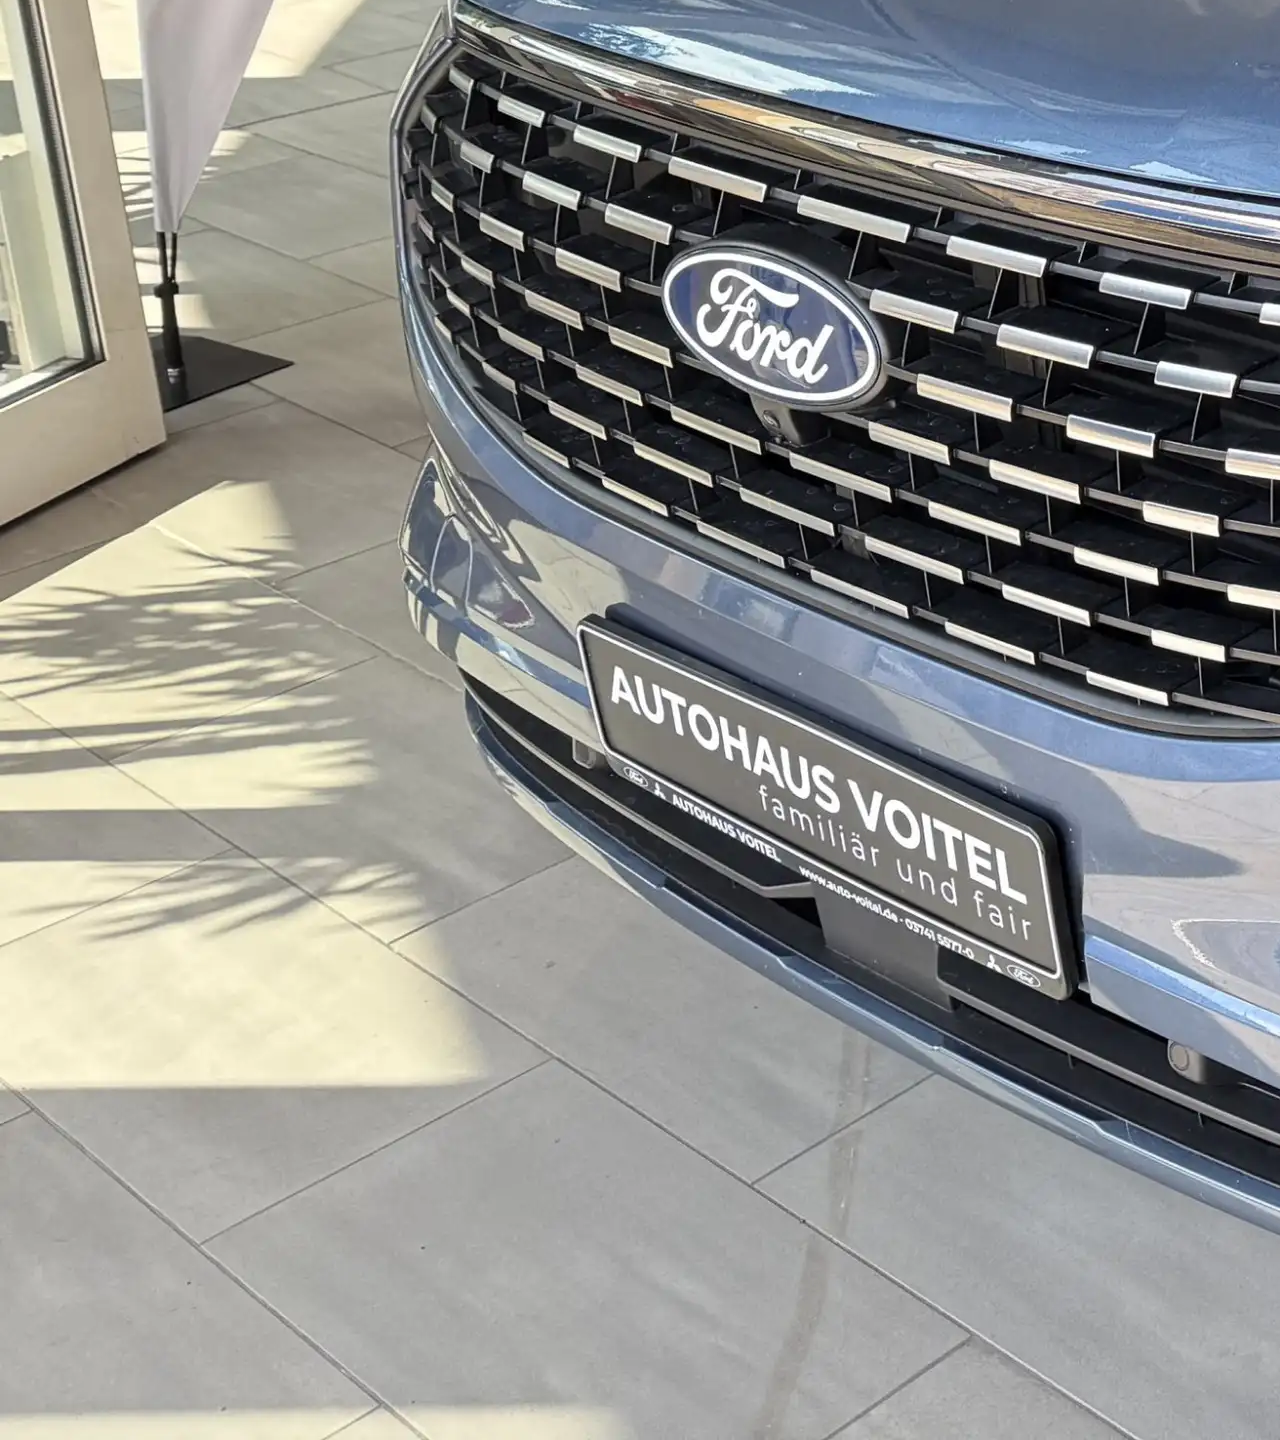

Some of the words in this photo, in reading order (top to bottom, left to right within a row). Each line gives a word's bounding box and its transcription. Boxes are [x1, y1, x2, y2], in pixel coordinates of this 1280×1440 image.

[696, 268, 835, 385] Ford
[610, 665, 841, 814] AUTOHAUS
[847, 778, 1028, 905] VOITEL
[672, 794, 737, 839] AUTOHAUS
[737, 829, 783, 864] VOITEL
[758, 784, 880, 868] familiär
[896, 858, 958, 907] und
[972, 891, 1032, 941] fair
